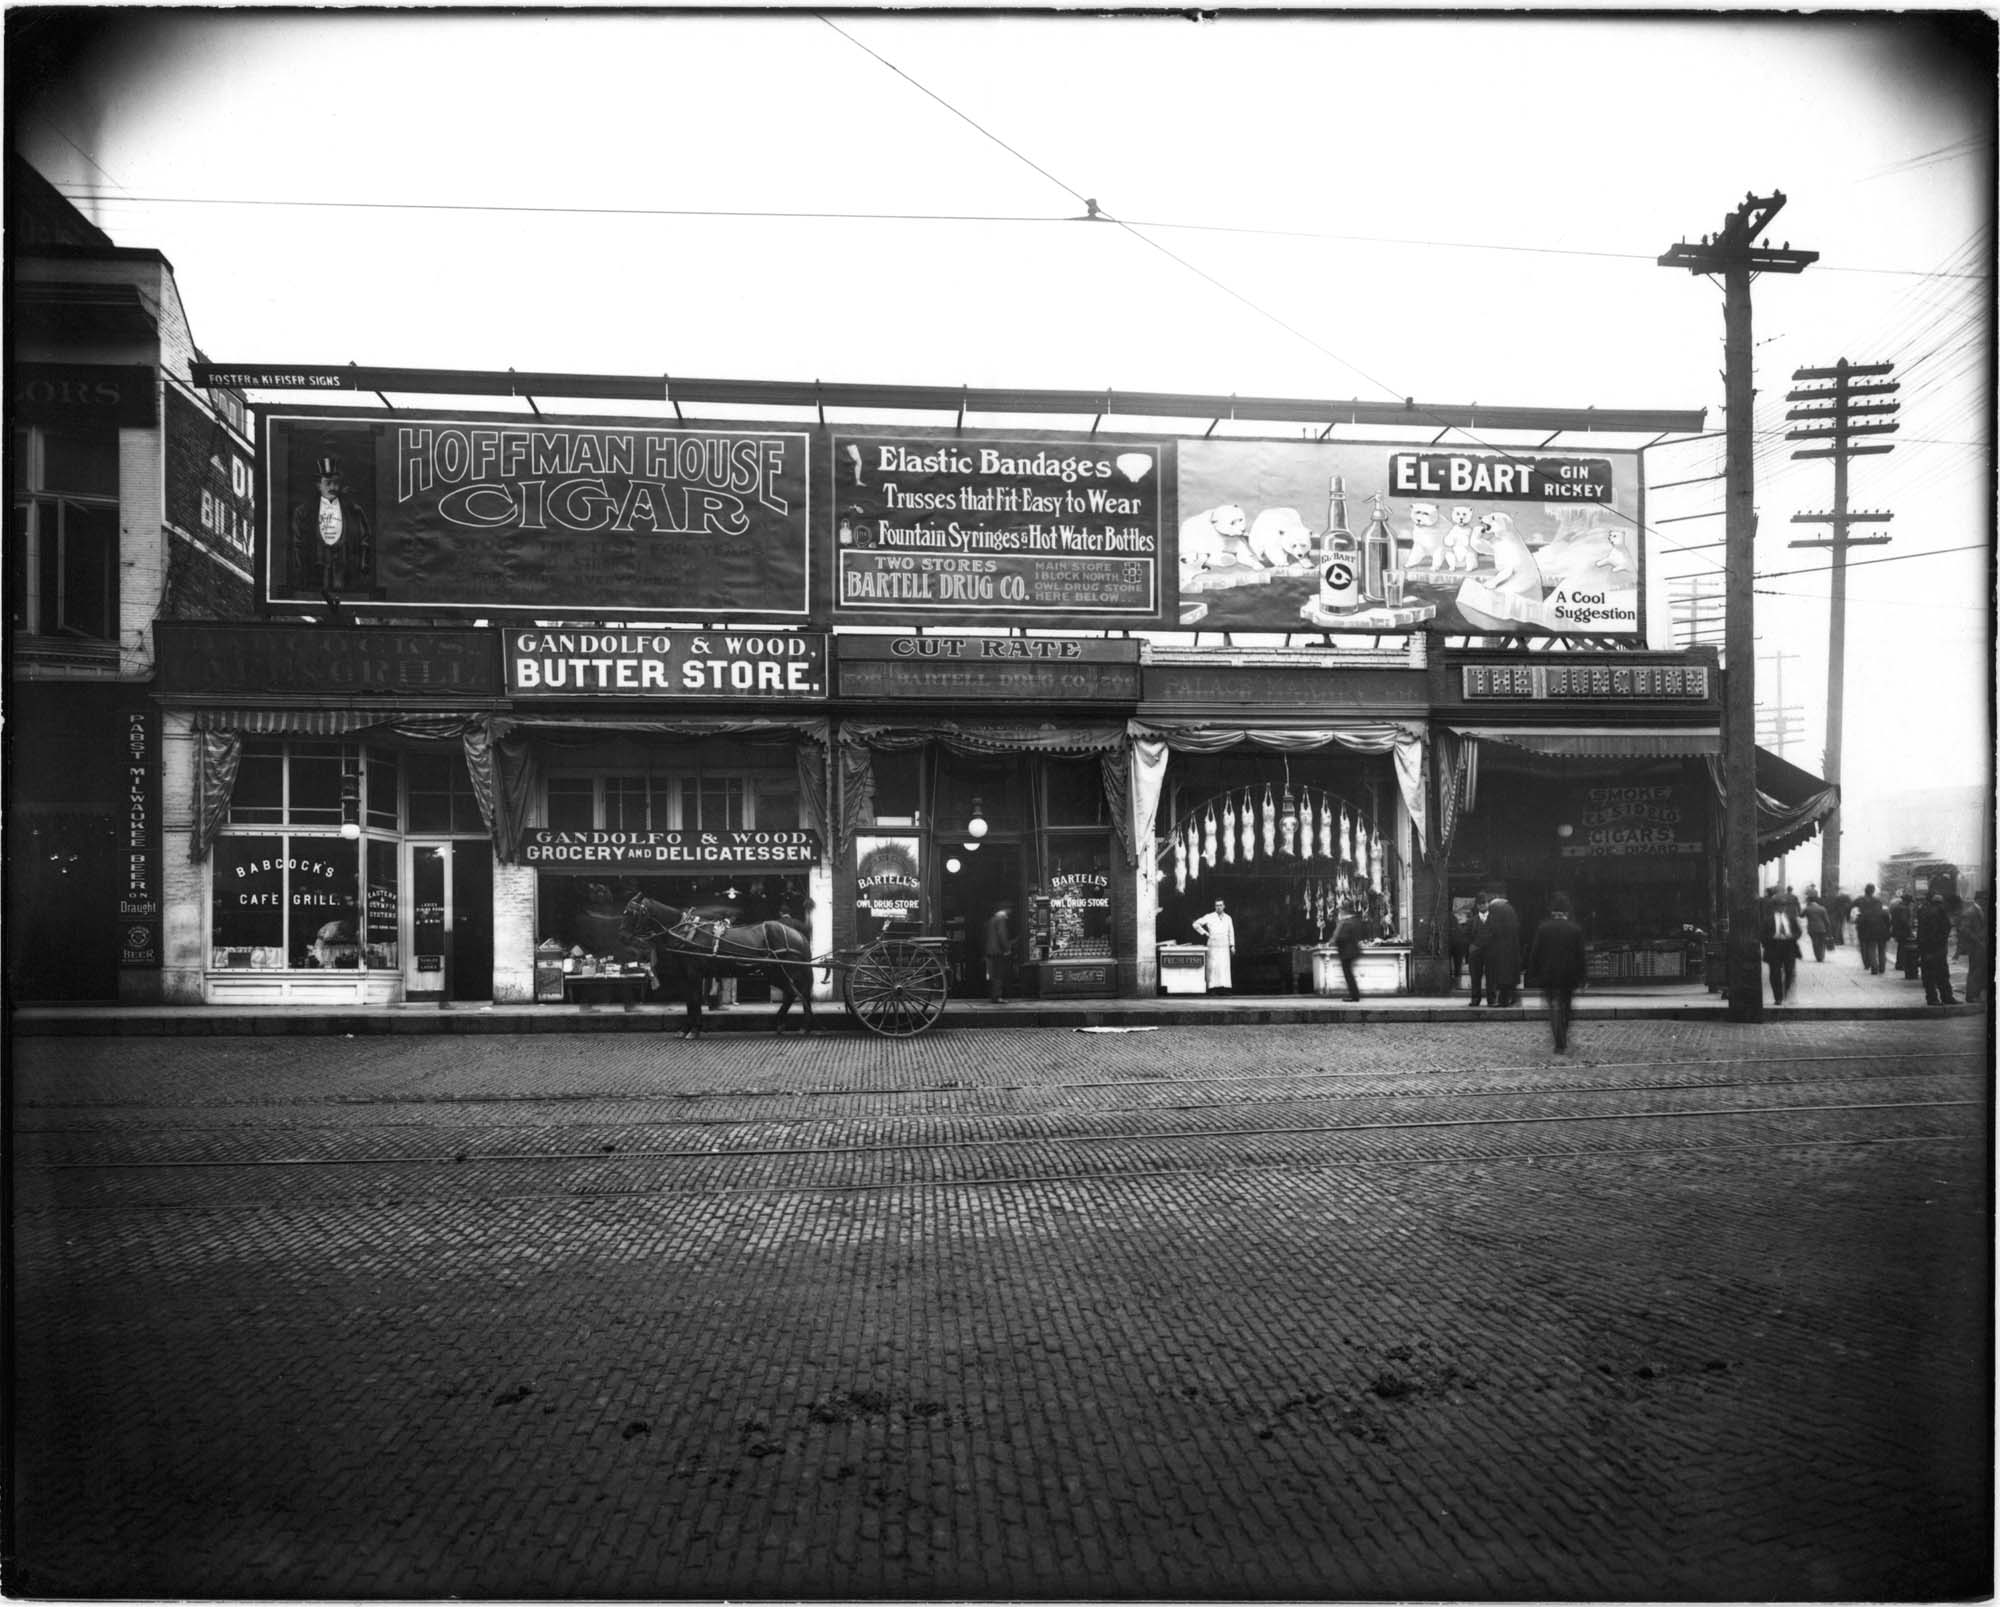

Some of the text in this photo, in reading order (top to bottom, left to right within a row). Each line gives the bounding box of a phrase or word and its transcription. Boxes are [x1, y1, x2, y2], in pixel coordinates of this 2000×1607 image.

[209, 374, 251, 385] FOSTER
[309, 376, 340, 387] SIGNS
[398, 428, 788, 515] HOFFMAN HOUSE
[877, 446, 1112, 483] Elastic Bandages
[1560, 465, 1589, 480] GIN
[1544, 483, 1604, 497] RICKEY
[883, 483, 956, 511] Trusses
[960, 486, 994, 511] that
[1066, 489, 1086, 513] to
[1088, 489, 1142, 514] Wear
[438, 479, 750, 535] CIGAR
[878, 520, 1155, 552] Fountain Syringes & Hot Water Bottles
[874, 556, 998, 572] TWO STORES
[1034, 561, 1112, 572] MAIN STORE
[1041, 571, 1079, 582] BLOCK
[1082, 573, 1119, 583] NORTH
[847, 571, 1030, 601] BARTELL DRUG CO.
[1034, 581, 1143, 593] OWL DRUG STORE
[1035, 592, 1071, 601] HERE
[1556, 591, 1606, 605] A Cool
[1555, 605, 1637, 622] Suggestion
[517, 635, 671, 653] GANDOLFO
[691, 636, 712, 653] &
[890, 639, 1082, 658] CUT RATE
[516, 659, 819, 691] BUTTER STORE.
[1471, 669, 1704, 696] THE JUNCTION
[130, 714, 145, 760] PABST
[129, 767, 145, 847] MILWAUKEE
[536, 832, 813, 844] GANDOLFO & WOOD.
[1592, 828, 1672, 843] CIGARS
[527, 846, 818, 861] GROCERY AND DELICATESSEN.
[130, 854, 146, 889] BEER
[236, 858, 335, 878] BABCOCK'S
[858, 874, 920, 889] BARTELL'S
[1051, 873, 1109, 888] BARTELL'S
[120, 901, 157, 915] Draught
[856, 900, 919, 909] OWL DRUG STORE
[1050, 898, 1109, 908] OWL DRUG STORE
